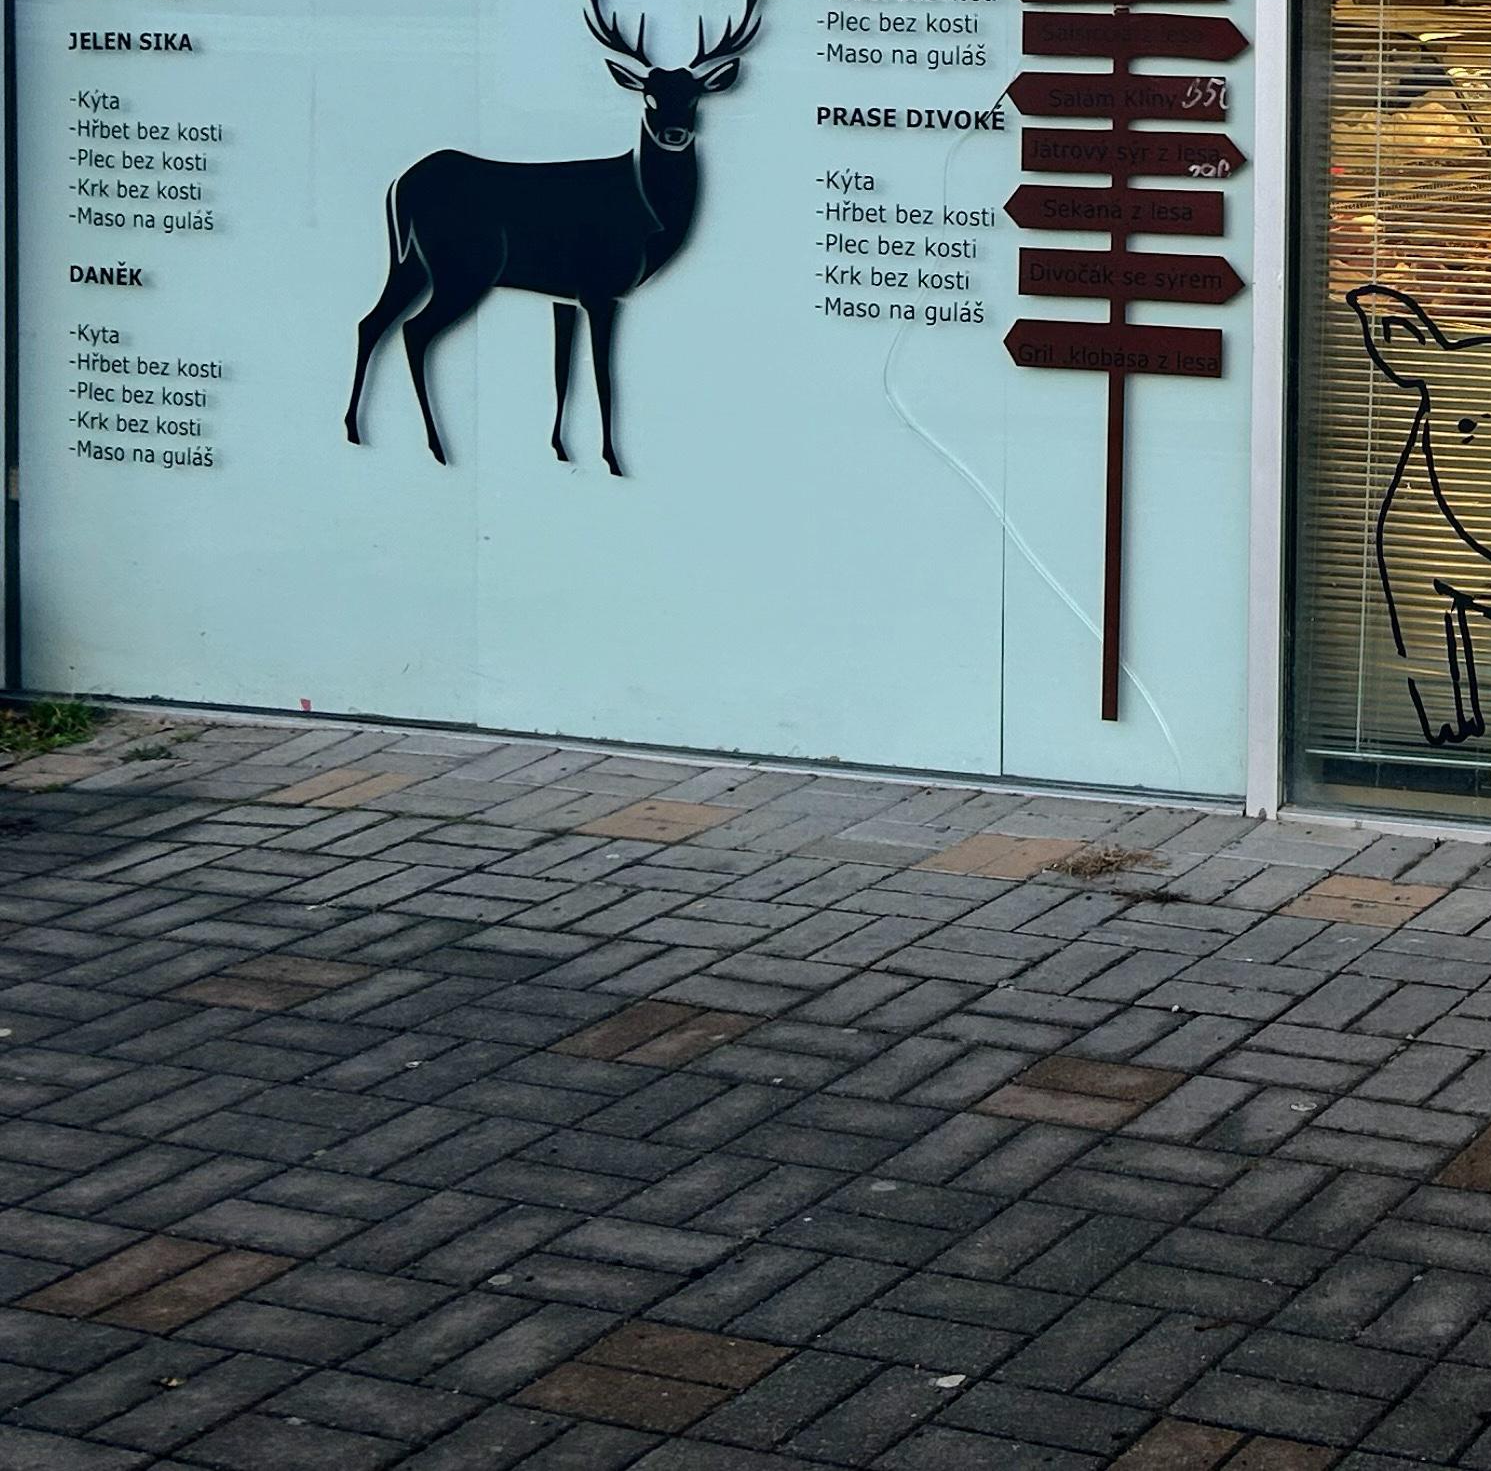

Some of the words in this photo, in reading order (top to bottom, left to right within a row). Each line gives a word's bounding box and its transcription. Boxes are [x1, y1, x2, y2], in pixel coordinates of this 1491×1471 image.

[817, 11, 871, 32] -Plec
[880, 12, 917, 33] bez
[926, 13, 978, 34] kosti
[68, 32, 132, 51] JELEN
[139, 33, 193, 51] SIKA
[817, 44, 883, 64] -Maso
[892, 50, 918, 65] na
[927, 44, 986, 70] guláš
[69, 89, 120, 112] -Kýta
[817, 106, 897, 129] PRASE
[906, 104, 1005, 131] DIVOKÉ
[69, 120, 129, 141] -Hřbet
[137, 122, 170, 141] bez
[177, 123, 222, 143] kosti
[69, 149, 115, 170] -Plec
[122, 150, 154, 170] bez
[162, 152, 207, 171] kosti
[1158, 147, 1170, 162] z
[69, 180, 109, 199] -Krk
[117, 180, 149, 199] bez
[157, 181, 201, 201] kosti
[816, 168, 875, 194] -Kýta
[69, 208, 125, 228] -Maso
[133, 213, 155, 229] na
[163, 210, 214, 234] guláš
[816, 201, 887, 223] -Hřbet
[896, 203, 933, 225] bez
[943, 205, 995, 227] kosti
[1043, 197, 1123, 219] Sekaná
[1131, 204, 1143, 219] z
[1151, 201, 1194, 221] lesa
[816, 233, 869, 255] -Plec
[878, 235, 915, 257] bez
[925, 237, 977, 259] kosti
[69, 261, 143, 287] DANĚK
[815, 266, 862, 286] -Krk
[871, 267, 908, 288] bez
[918, 269, 969, 290] kosti
[1029, 261, 1115, 284] Divočák
[1122, 271, 1148, 286] se
[815, 297, 880, 320] -Maso
[890, 304, 915, 320] na
[925, 299, 984, 325] guláš
[69, 352, 130, 374] -Hřbet
[137, 357, 170, 376] bez
[177, 359, 222, 379] kosti
[1018, 343, 1053, 366] Gril
[1158, 355, 1169, 370] z
[1176, 351, 1219, 372] lesa
[69, 381, 115, 402] -Plec
[122, 384, 154, 405] bez
[162, 387, 206, 407] kosti
[69, 411, 108, 431] -Krk
[116, 413, 149, 433] bez
[156, 415, 201, 437] kosti
[69, 440, 125, 462] -Maso
[133, 448, 155, 464] na
[163, 446, 213, 468] guláš
